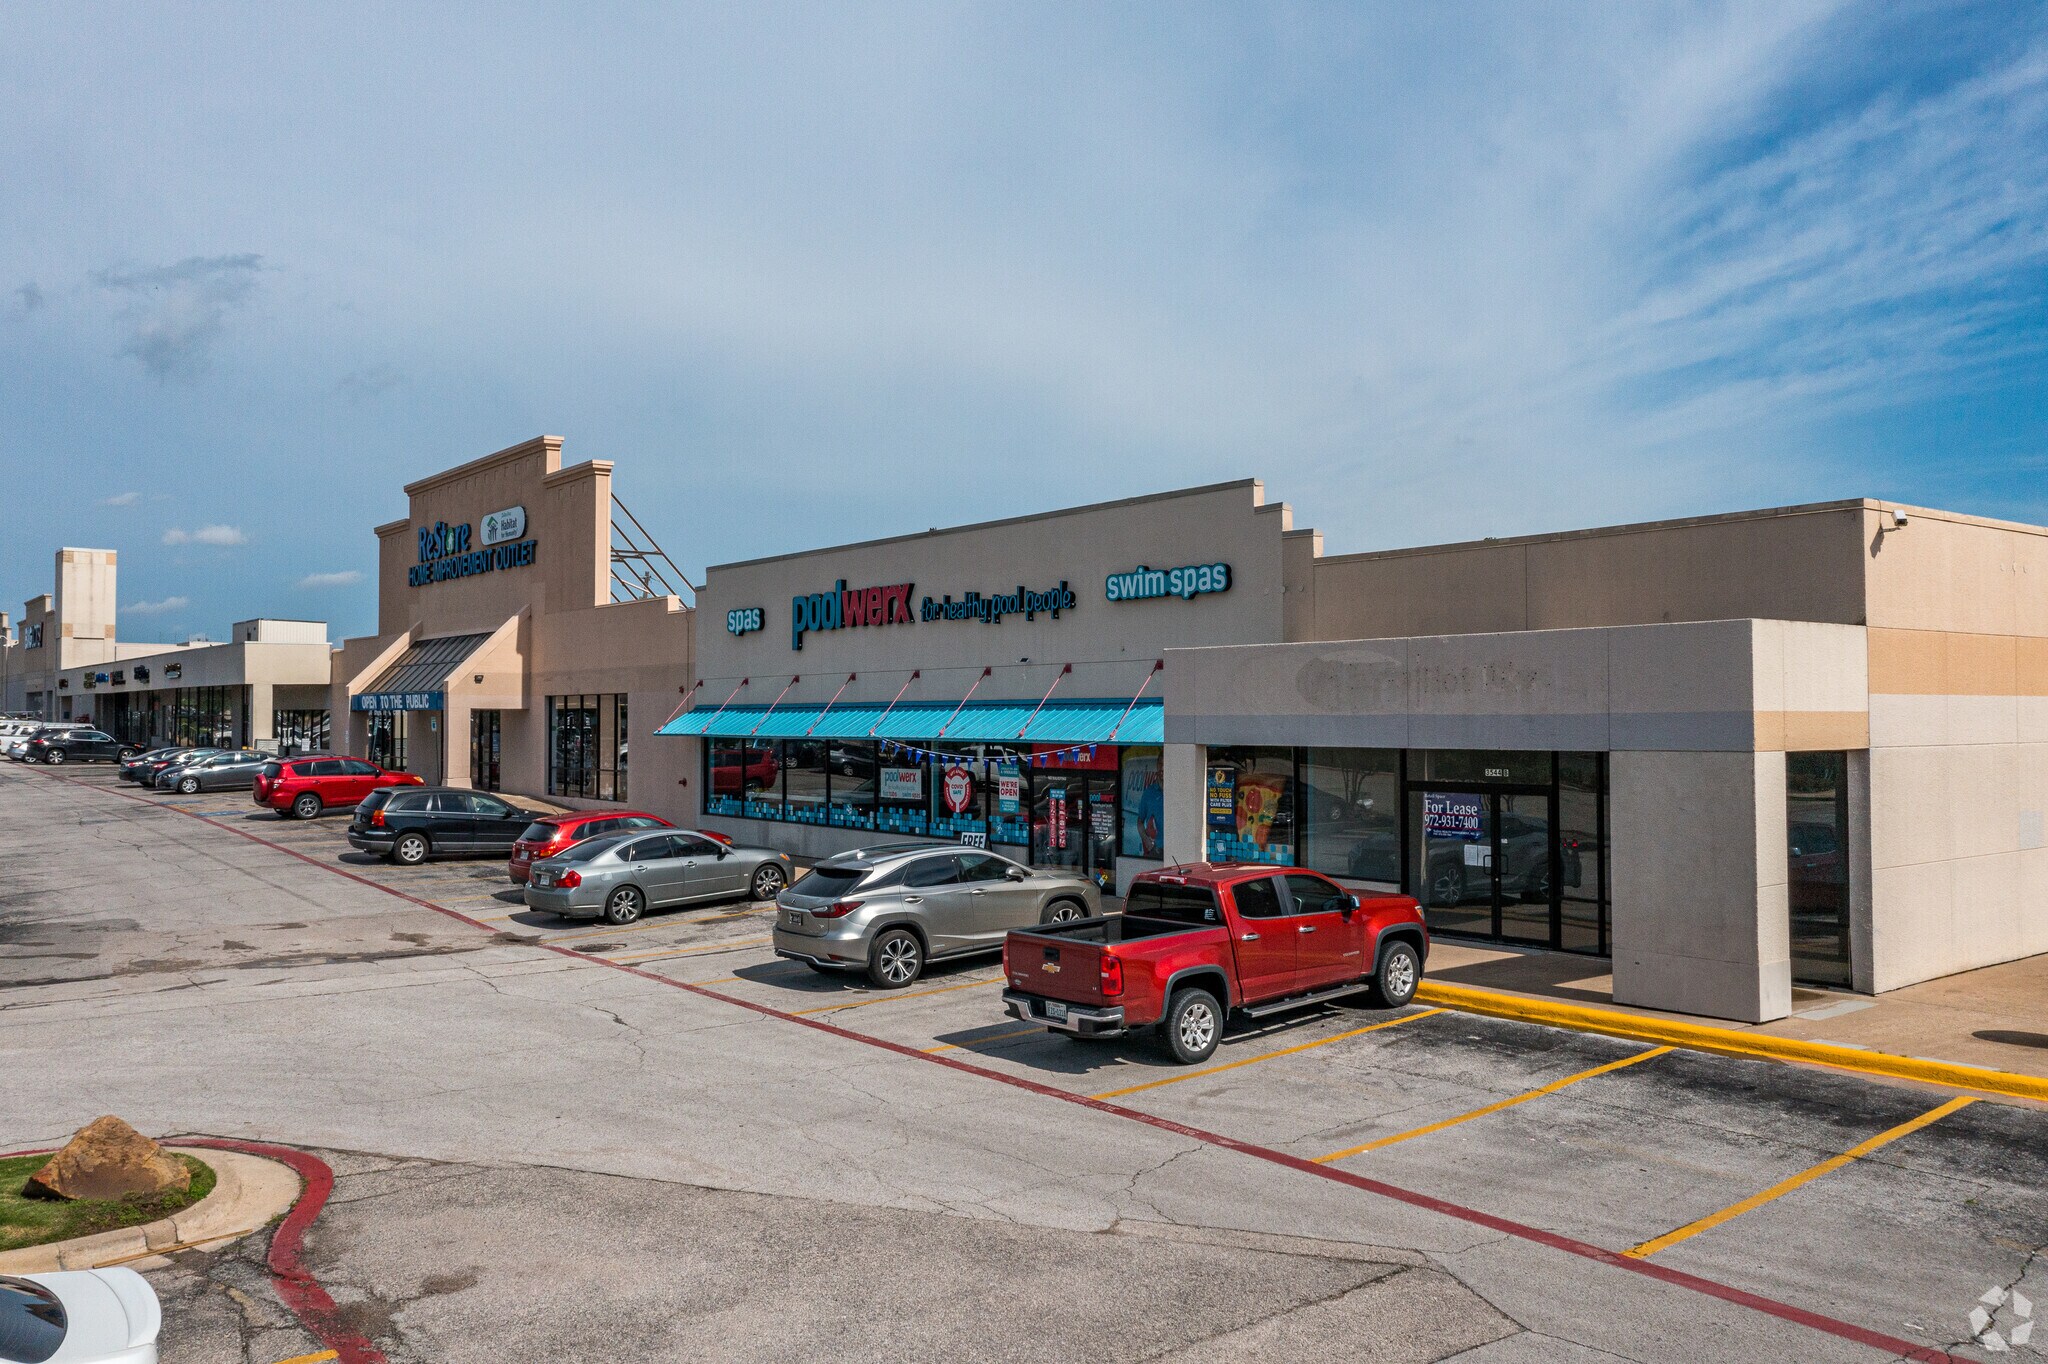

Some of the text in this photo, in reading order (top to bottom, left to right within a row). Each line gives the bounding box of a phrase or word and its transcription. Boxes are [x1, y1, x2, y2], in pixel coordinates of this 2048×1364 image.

[418, 521, 471, 562] ReStore
[409, 539, 537, 586] HOME IMPROVEMENT OUTLET
[1107, 562, 1231, 600] swim spas
[792, 579, 915, 650] poolwerx
[921, 596, 941, 622] for
[942, 591, 991, 623] healthy
[991, 585, 1024, 624] pool
[727, 608, 763, 635] spas
[361, 694, 429, 709] OPEN TO THE PUBLIC
[885, 769, 917, 786] poolwerx
[1424, 799, 1478, 816] For Lease
[1424, 814, 1479, 829] 972-931-7400
